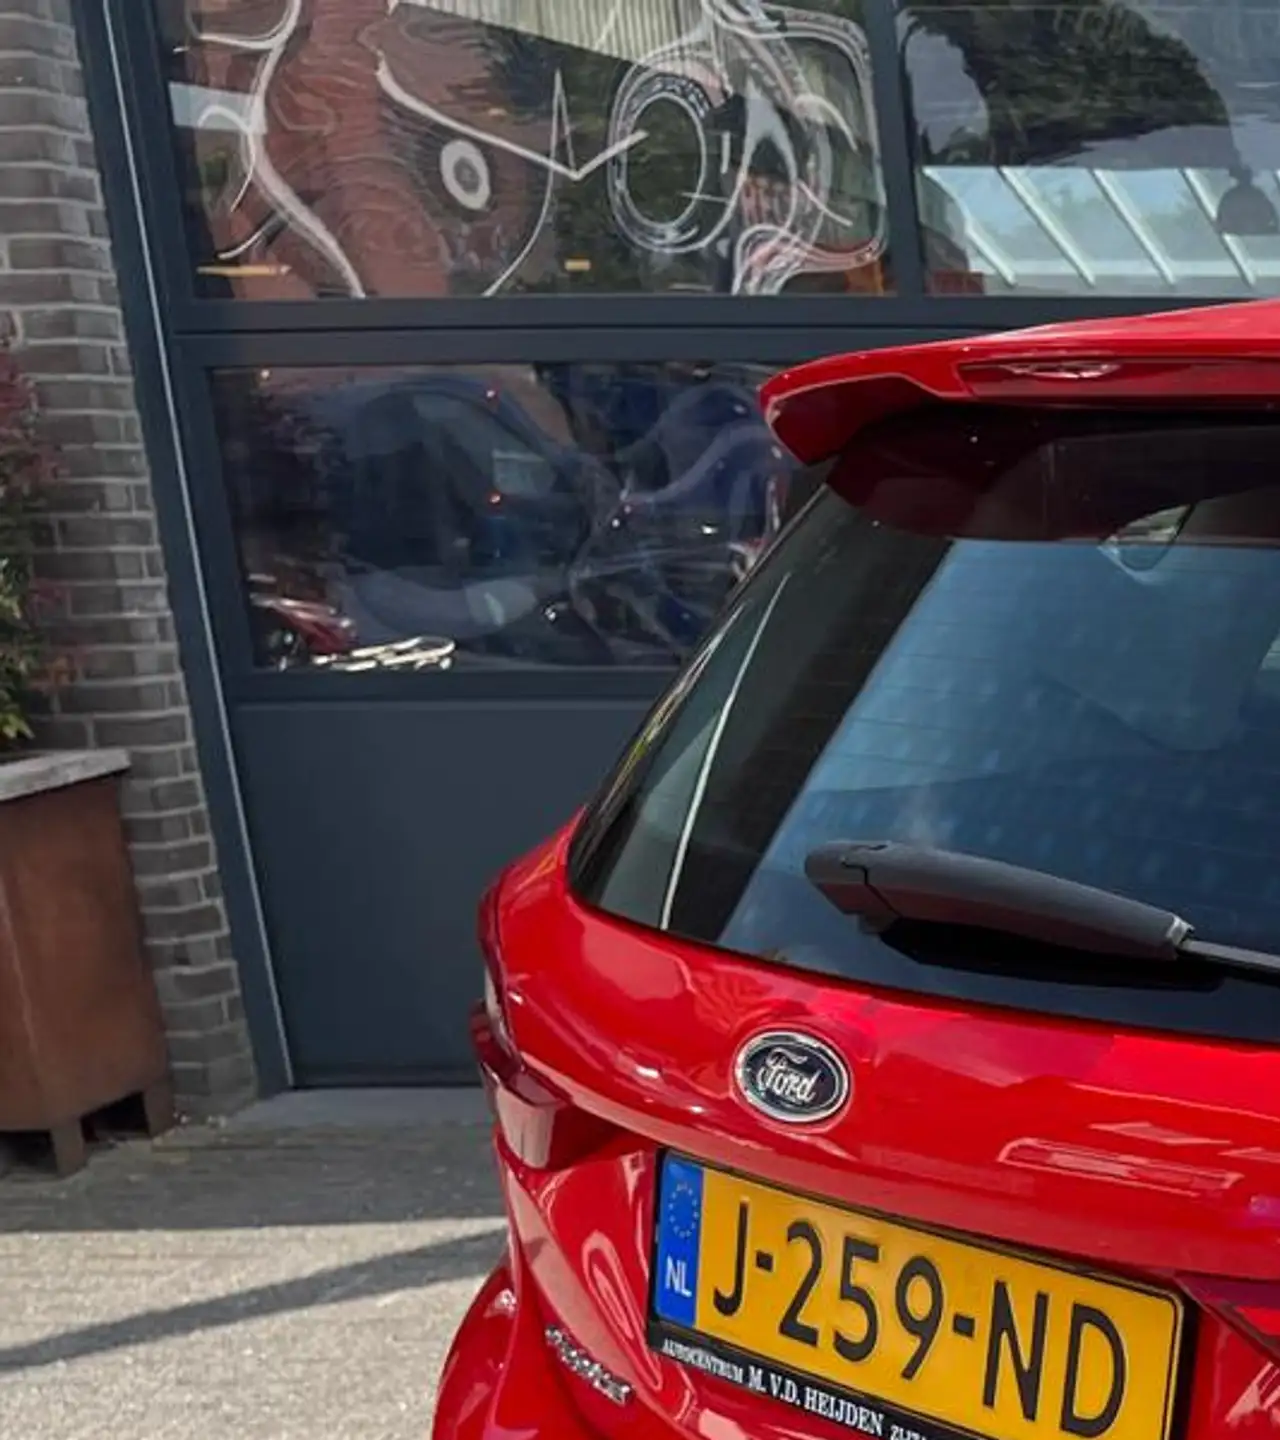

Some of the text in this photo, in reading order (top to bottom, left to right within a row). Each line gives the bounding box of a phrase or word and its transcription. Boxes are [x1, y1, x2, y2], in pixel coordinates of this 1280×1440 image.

[756, 1047, 822, 1104] Ford
[664, 1256, 693, 1299] NL
[713, 1200, 1127, 1440] J-259-ND
[769, 1373, 801, 1406] V.D.
[803, 1385, 885, 1437] HEIJDEN
